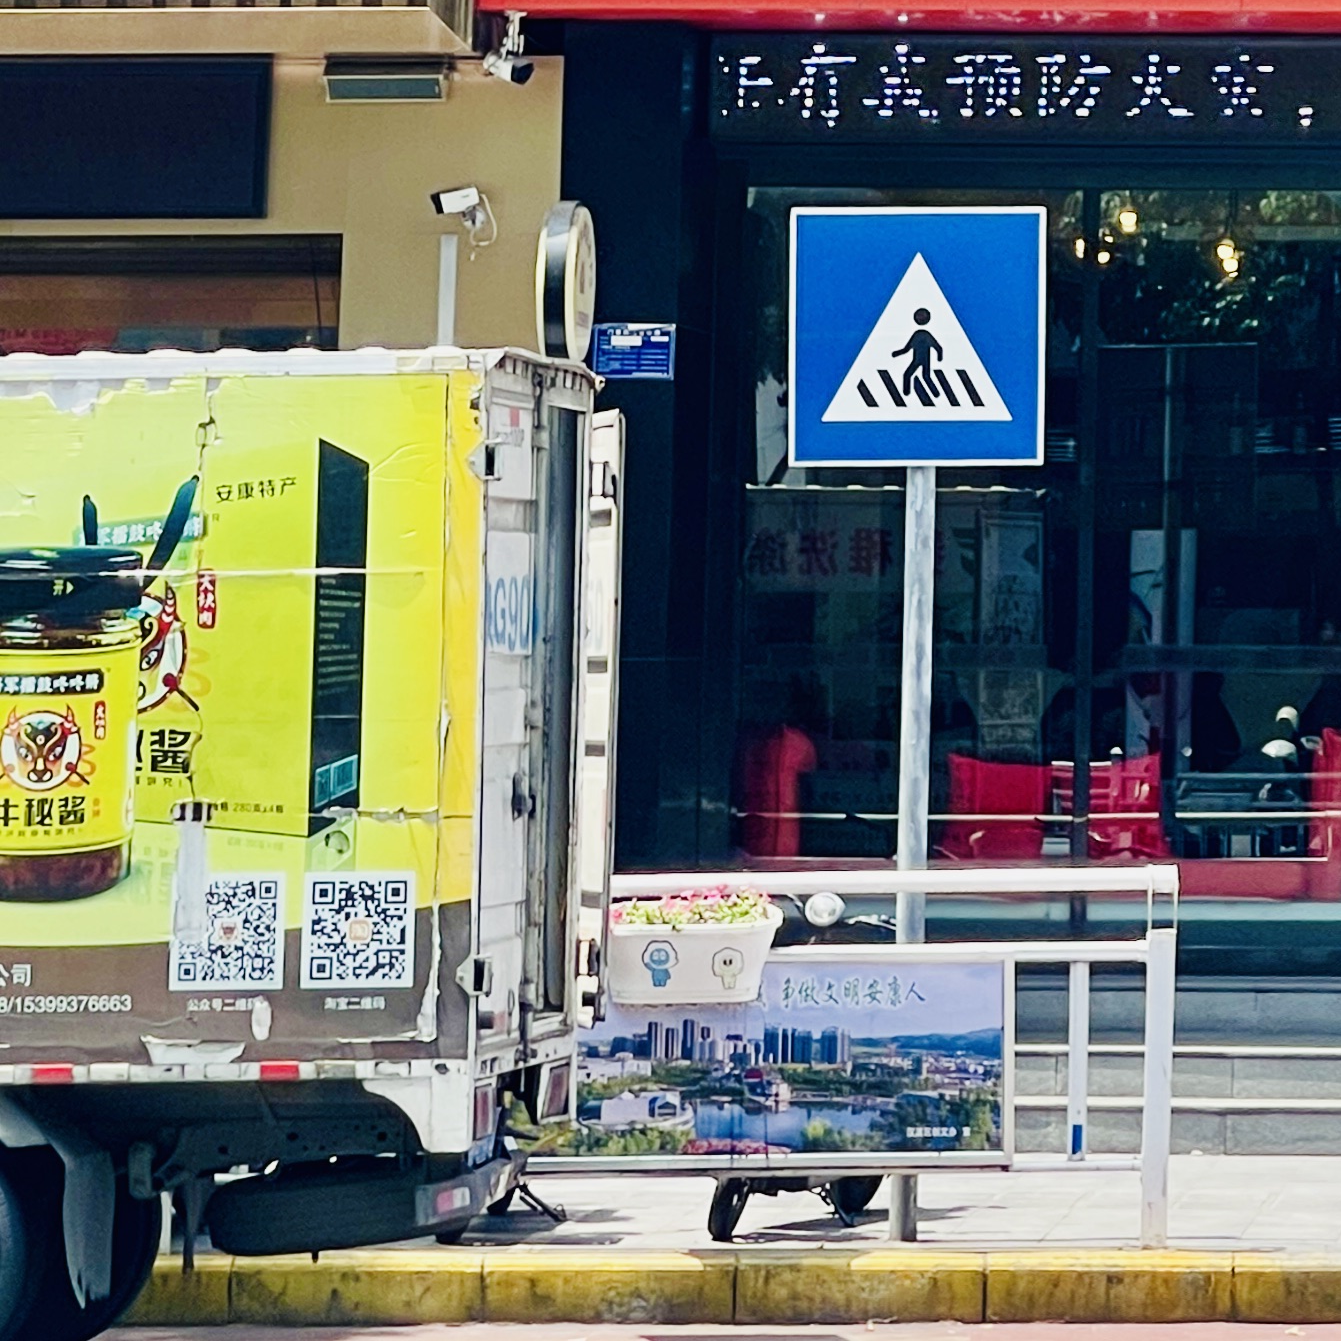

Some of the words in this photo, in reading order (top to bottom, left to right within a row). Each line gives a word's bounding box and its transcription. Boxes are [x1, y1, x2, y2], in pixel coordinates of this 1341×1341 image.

[215, 477, 297, 504] 安康特产
[136, 729, 192, 774] 酱
[782, 976, 925, 1009] 争做文明安康人
